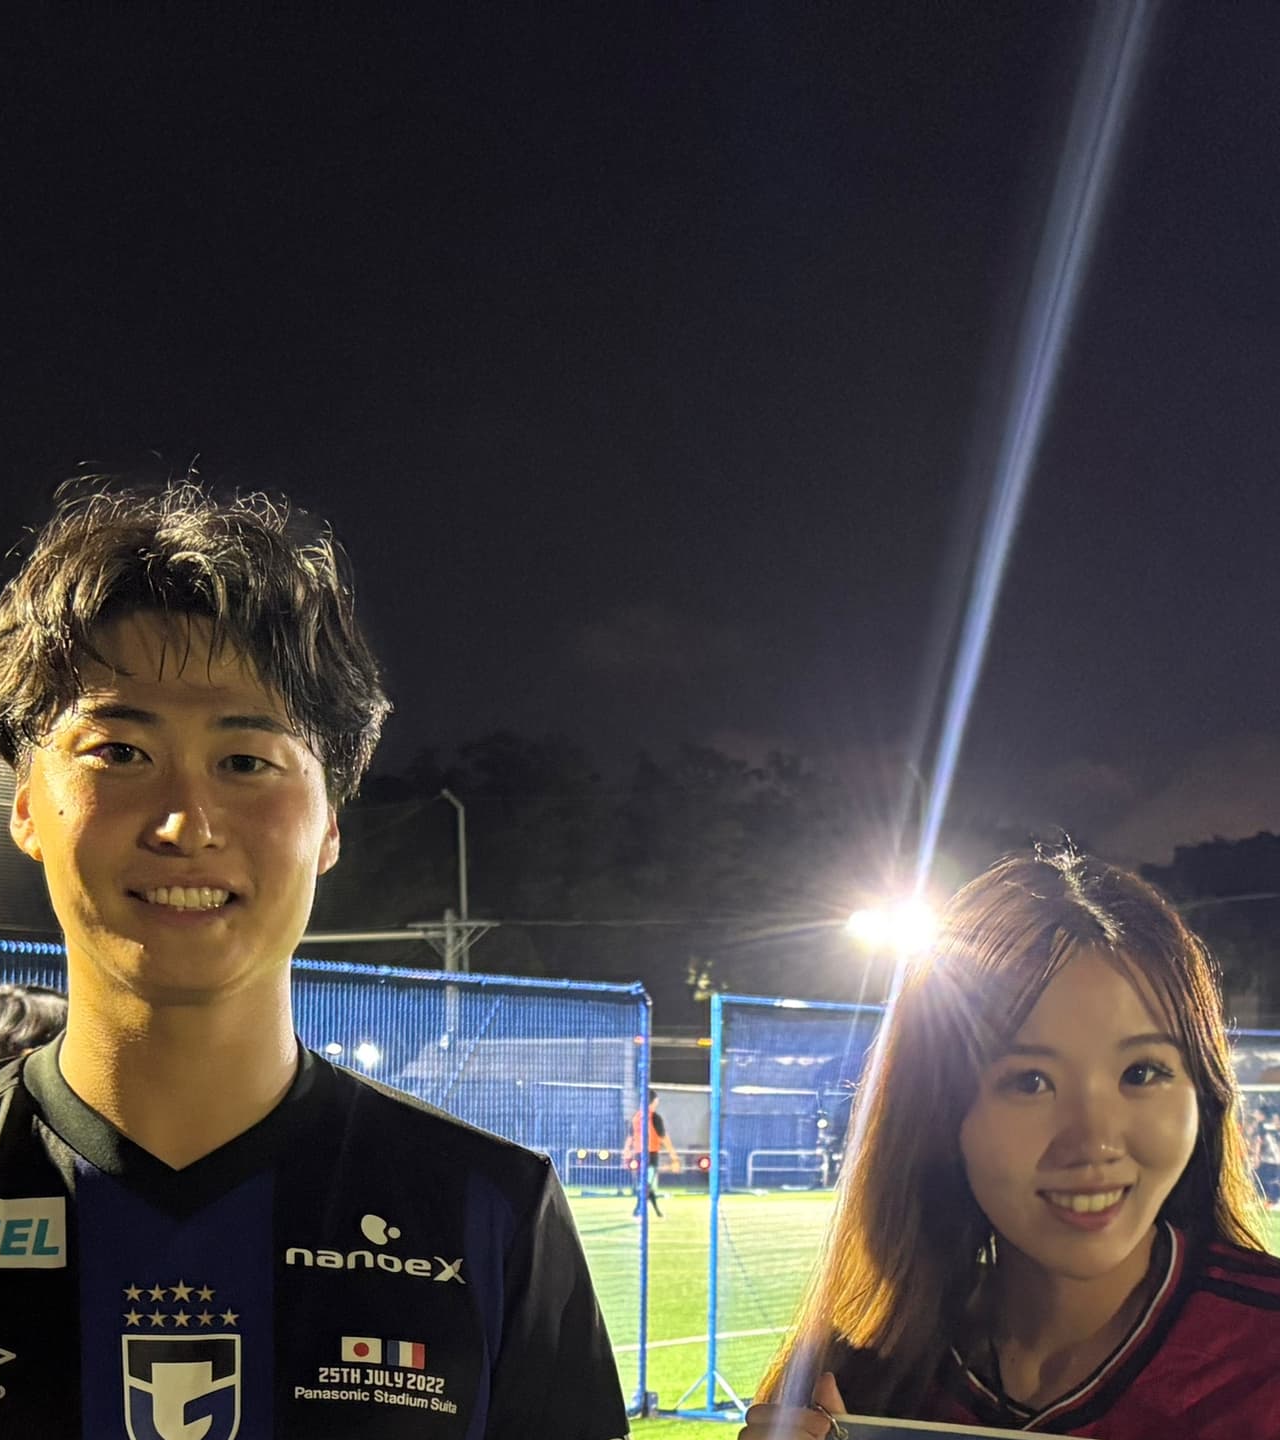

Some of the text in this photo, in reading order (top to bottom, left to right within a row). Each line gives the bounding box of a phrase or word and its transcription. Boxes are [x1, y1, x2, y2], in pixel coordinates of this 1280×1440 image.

[319, 1367, 446, 1395] 25TH JULY 2022
[294, 1386, 457, 1414] Panasonic Stadium Suita
